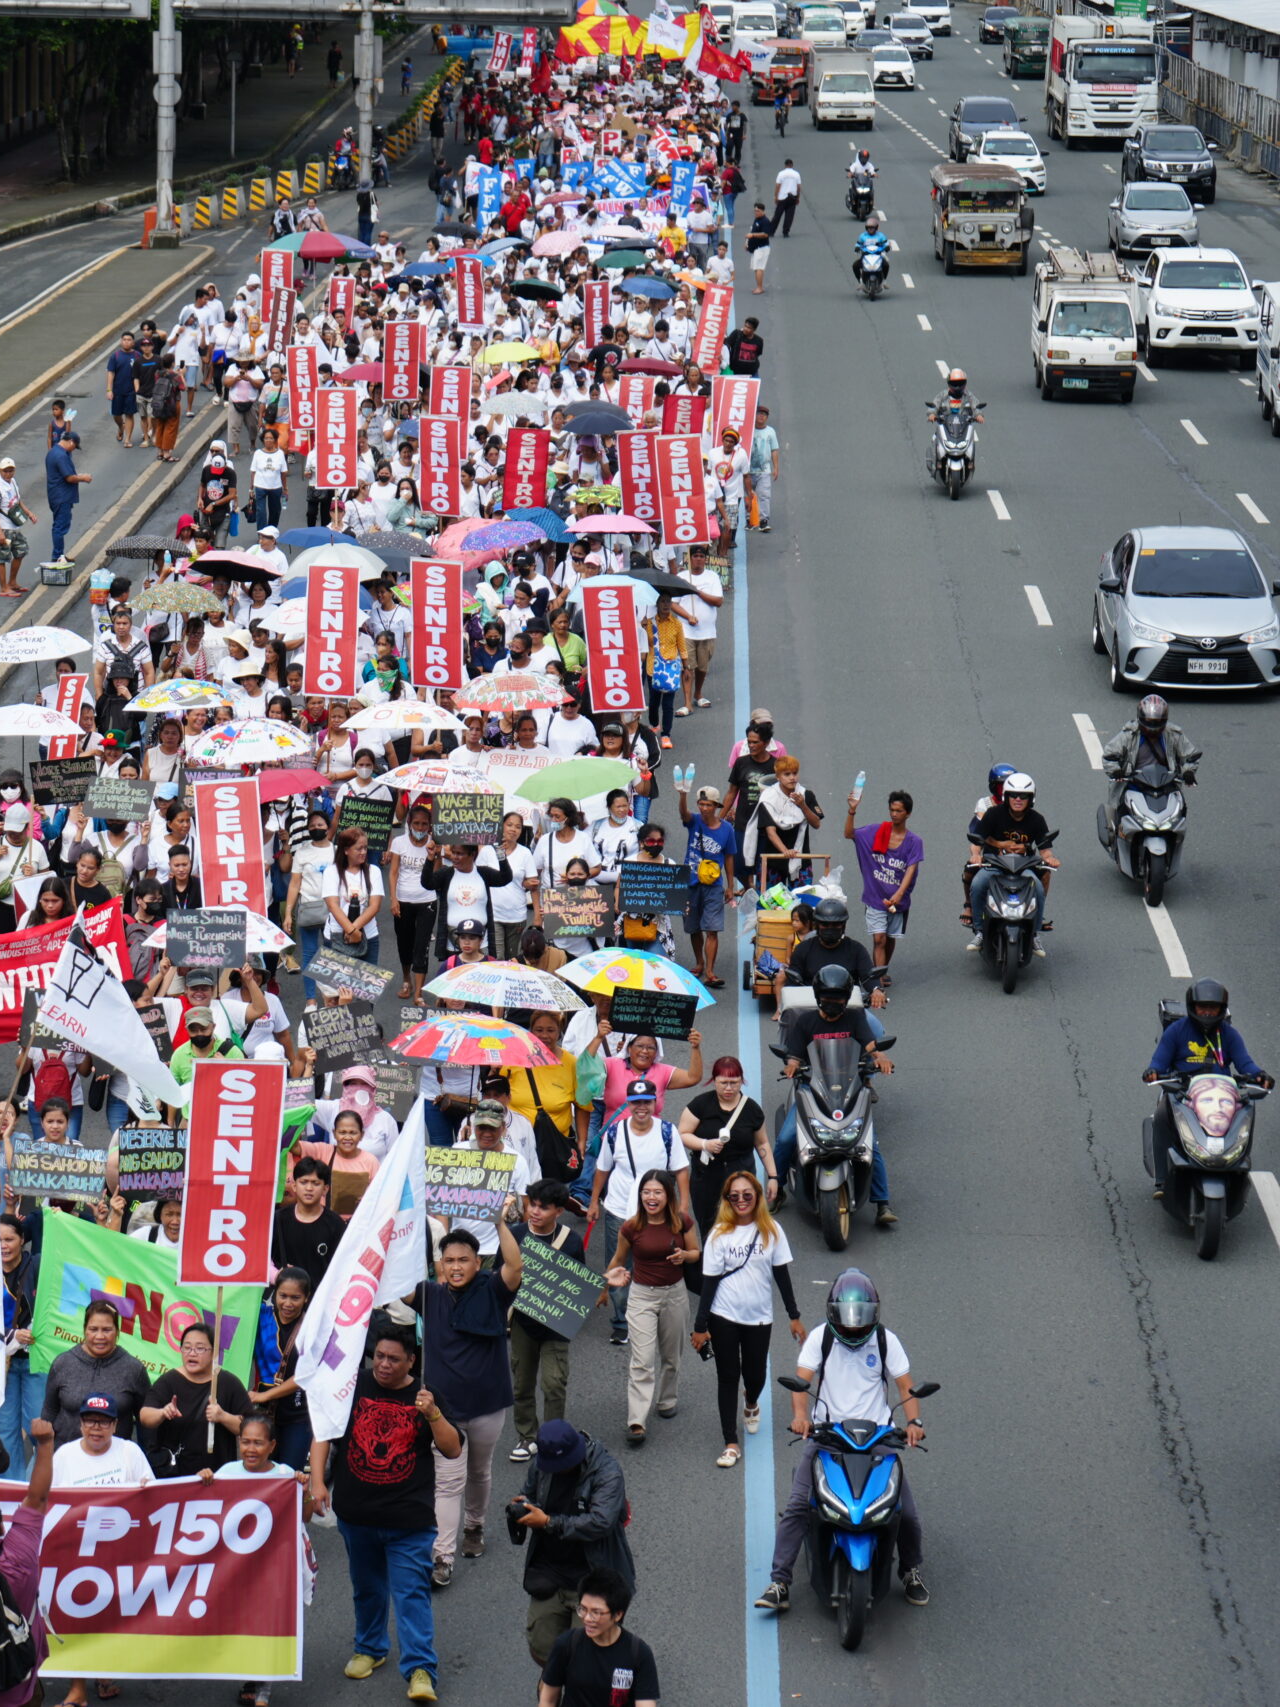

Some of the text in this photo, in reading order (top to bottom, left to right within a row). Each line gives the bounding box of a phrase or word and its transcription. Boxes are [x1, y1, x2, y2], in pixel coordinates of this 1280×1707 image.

[491, 32, 509, 70] KMU
[670, 166, 690, 217] FFW
[463, 259, 475, 322] TESEF
[273, 290, 289, 352] SENTRO
[699, 287, 728, 369] TESEF
[391, 324, 410, 398] SENTRO
[295, 348, 314, 427] SENTRO
[326, 391, 347, 485] SENTRO
[430, 421, 450, 513] SENTRO
[516, 433, 536, 507] SENTRO
[629, 435, 655, 519] SENTRO
[669, 440, 698, 541] SENTRO
[317, 569, 344, 692] SENTRO
[424, 565, 450, 684] SENTRO
[597, 589, 630, 707] SENTRO
[1189, 662, 1204, 670] NFH
[437, 794, 503, 809] WAGE HIKE
[213, 786, 249, 909] SENTR
[402, 856, 424, 866] GUES
[9, 937, 41, 948] WORKERS
[38, 1001, 88, 1038] LEARN
[812, 1031, 852, 1040] RESPECT
[14, 1139, 76, 1159] DESERVE
[14, 1154, 39, 1170] ANG
[40, 1156, 88, 1172] SAHOD
[120, 1129, 175, 1149] DESERVE
[120, 1151, 184, 1172] ANG SAHOD
[203, 1068, 258, 1278] SENTRO
[445, 1167, 510, 1192] SAHOD NA
[521, 1235, 554, 1263] SPEAKER
[555, 1293, 591, 1319] BILLS!
[560, 1279, 583, 1296] ANG
